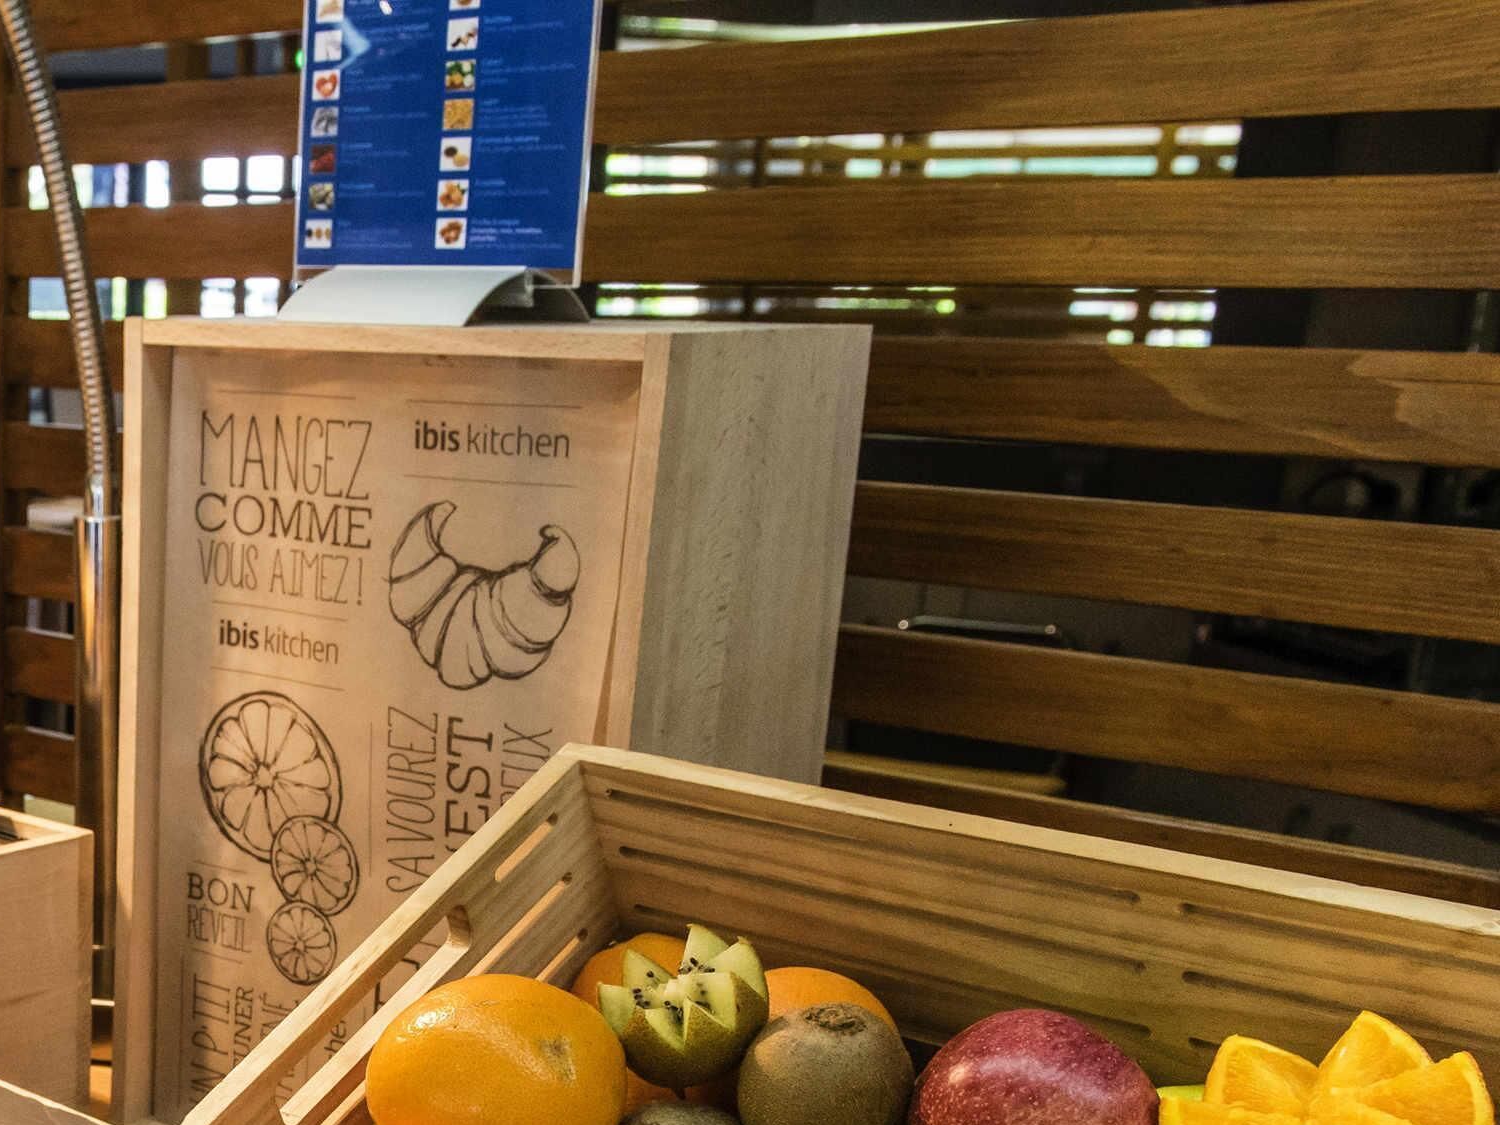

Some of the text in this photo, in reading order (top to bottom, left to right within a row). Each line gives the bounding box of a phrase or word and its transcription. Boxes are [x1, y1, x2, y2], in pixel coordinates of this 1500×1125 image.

[200, 409, 373, 500] MANGEZ
[415, 420, 570, 458] ibis kitchen
[195, 492, 372, 549] COMME
[197, 538, 259, 591] VOUS
[219, 619, 339, 664] ibis kitchen
[187, 872, 255, 913] BON
